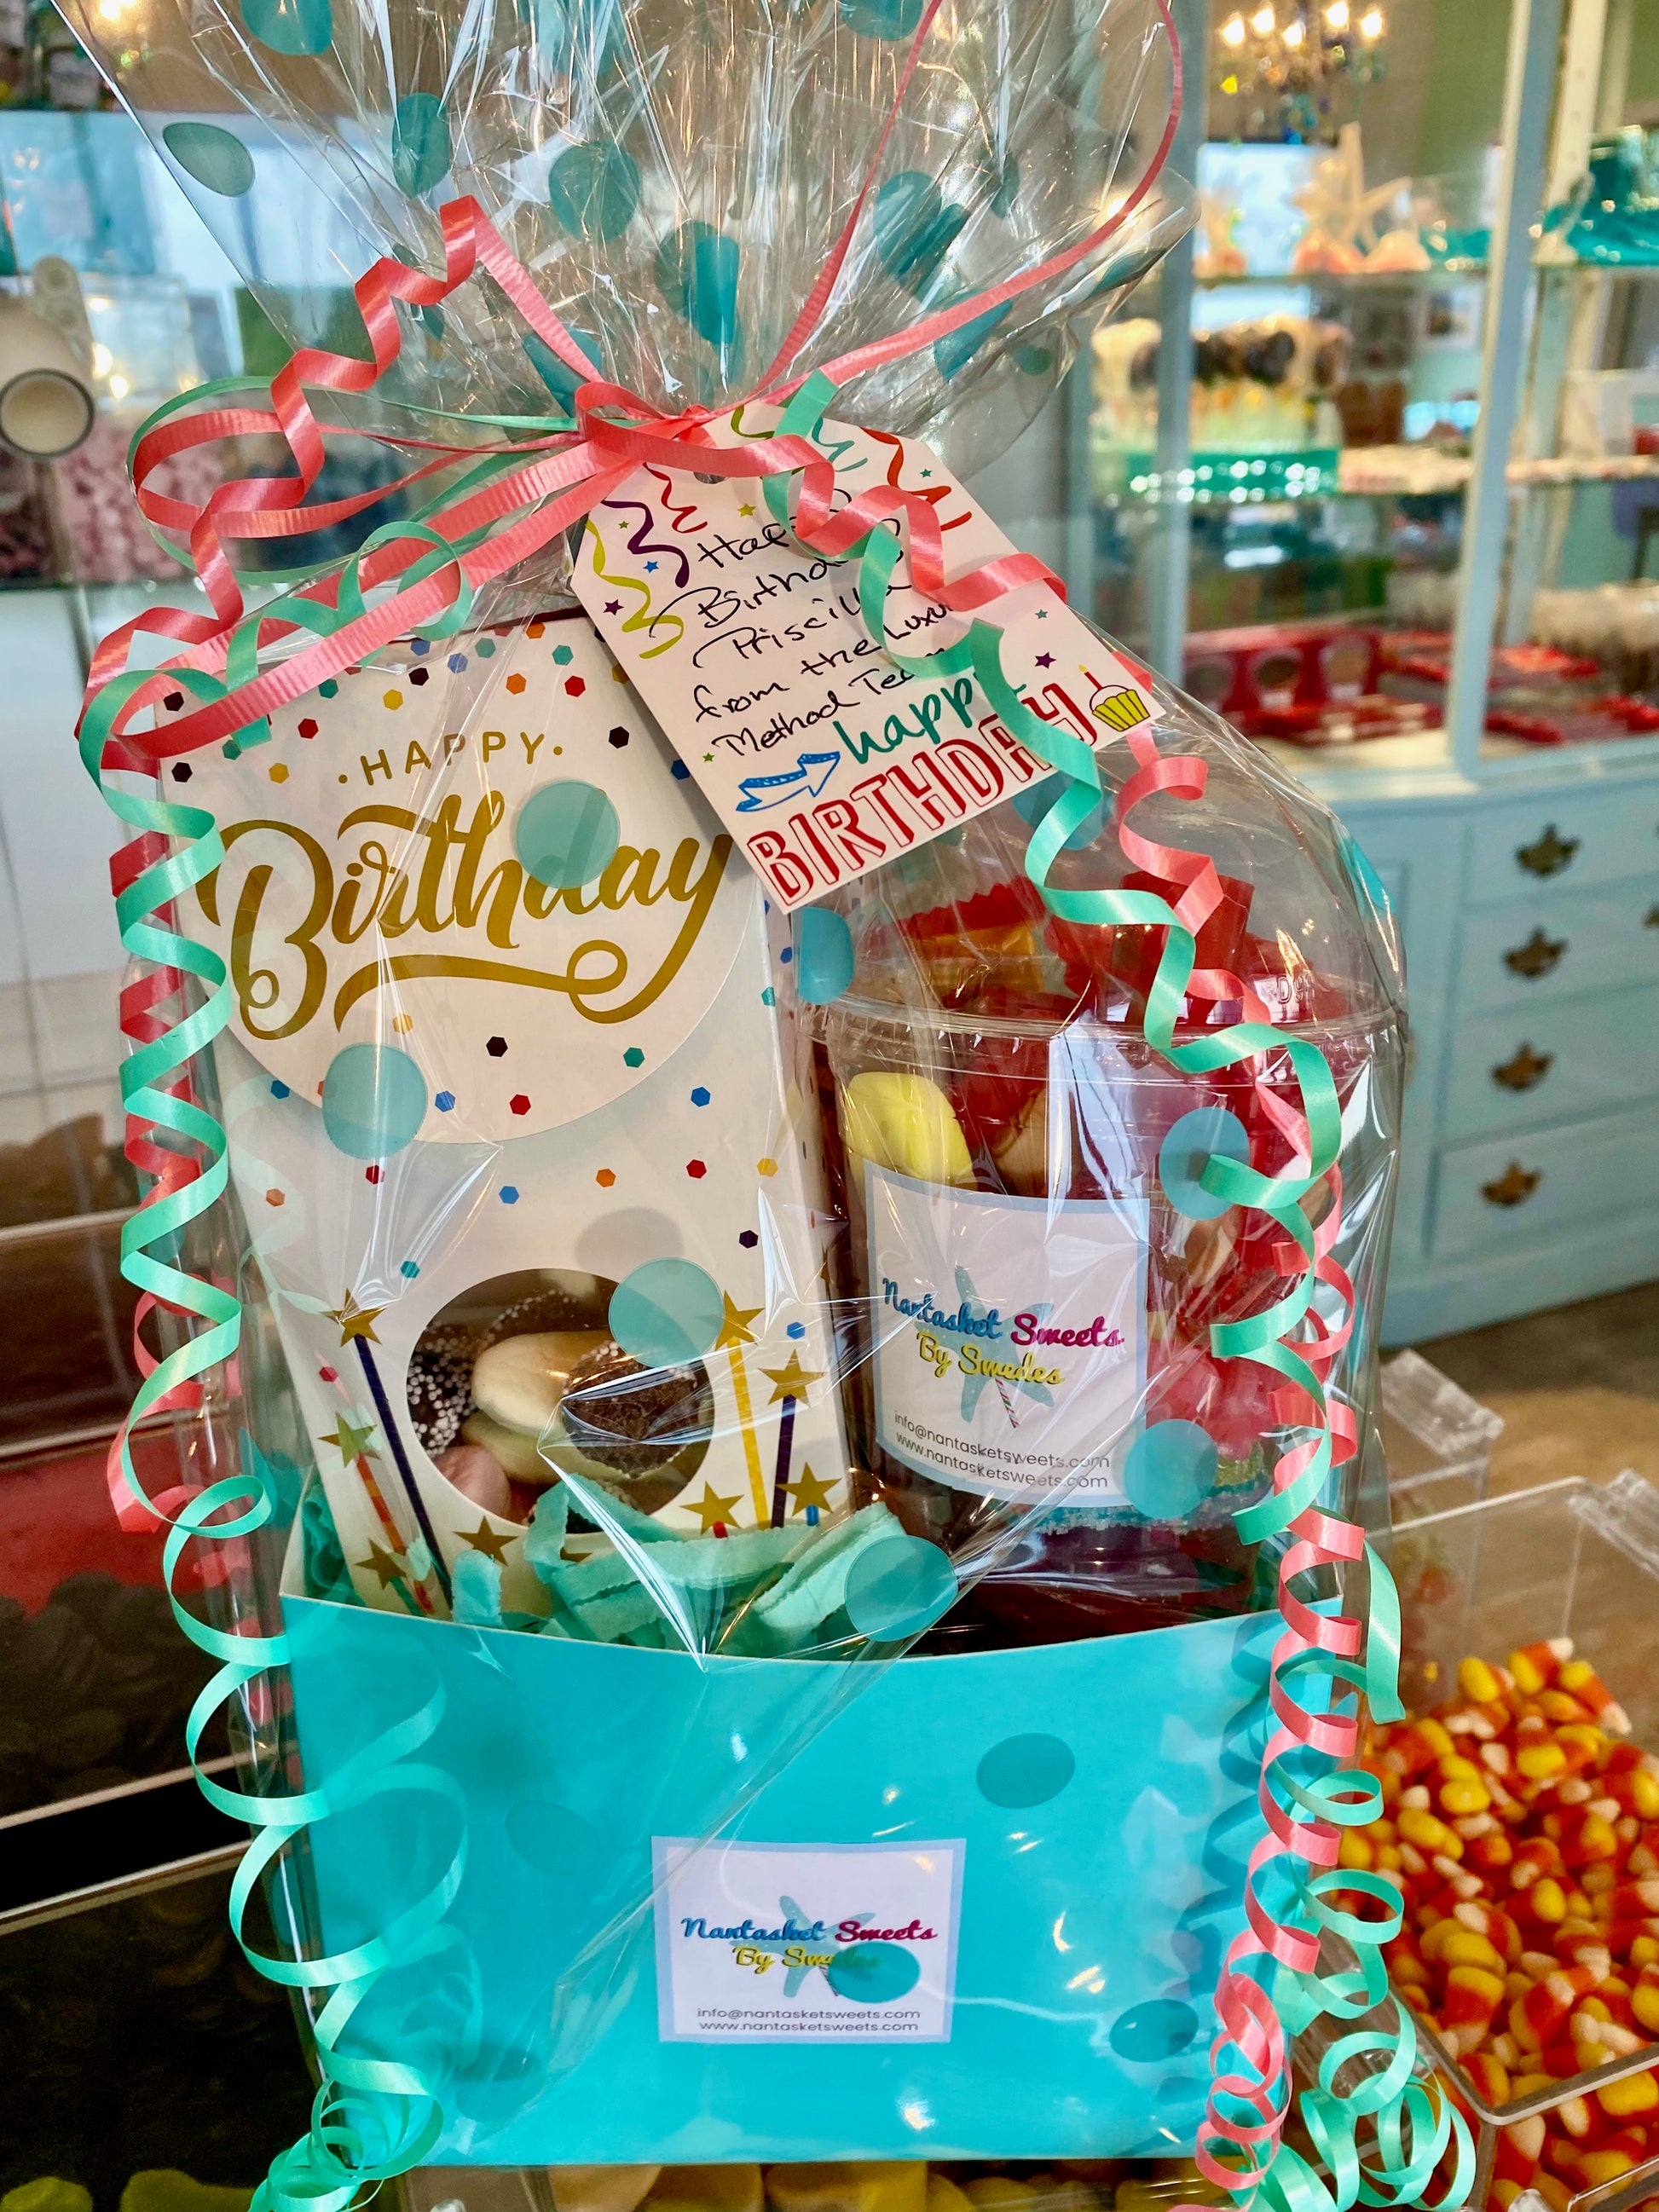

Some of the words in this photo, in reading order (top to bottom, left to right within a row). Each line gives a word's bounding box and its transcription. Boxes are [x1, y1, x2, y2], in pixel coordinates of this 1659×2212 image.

[693, 584, 912, 668] Priscill
[694, 681, 790, 723] from
[801, 637, 882, 676] the
[883, 603, 953, 640] Luxu
[711, 690, 860, 757] Method
[832, 671, 1027, 765] happ
[360, 731, 546, 786] HAPPY
[747, 683, 1099, 906] BIRTHDAY
[195, 789, 735, 1041] Birthday
[882, 1277, 1004, 1340] Nantasket
[1011, 1312, 1125, 1348] Sweets
[916, 1331, 952, 1378] By
[957, 1342, 1066, 1386] Swedes
[893, 1410, 1110, 1470] info@nantasketsweets.com
[895, 1431, 1108, 1488] www.nantasketsweets.com
[681, 1917, 827, 1942] Nantasket
[834, 1919, 939, 1943] Sweets
[731, 1946, 775, 1975] By
[697, 2007, 922, 2021] info@nantasketsweets.com
[698, 2020, 920, 2032] www.nantasketsweets.com
